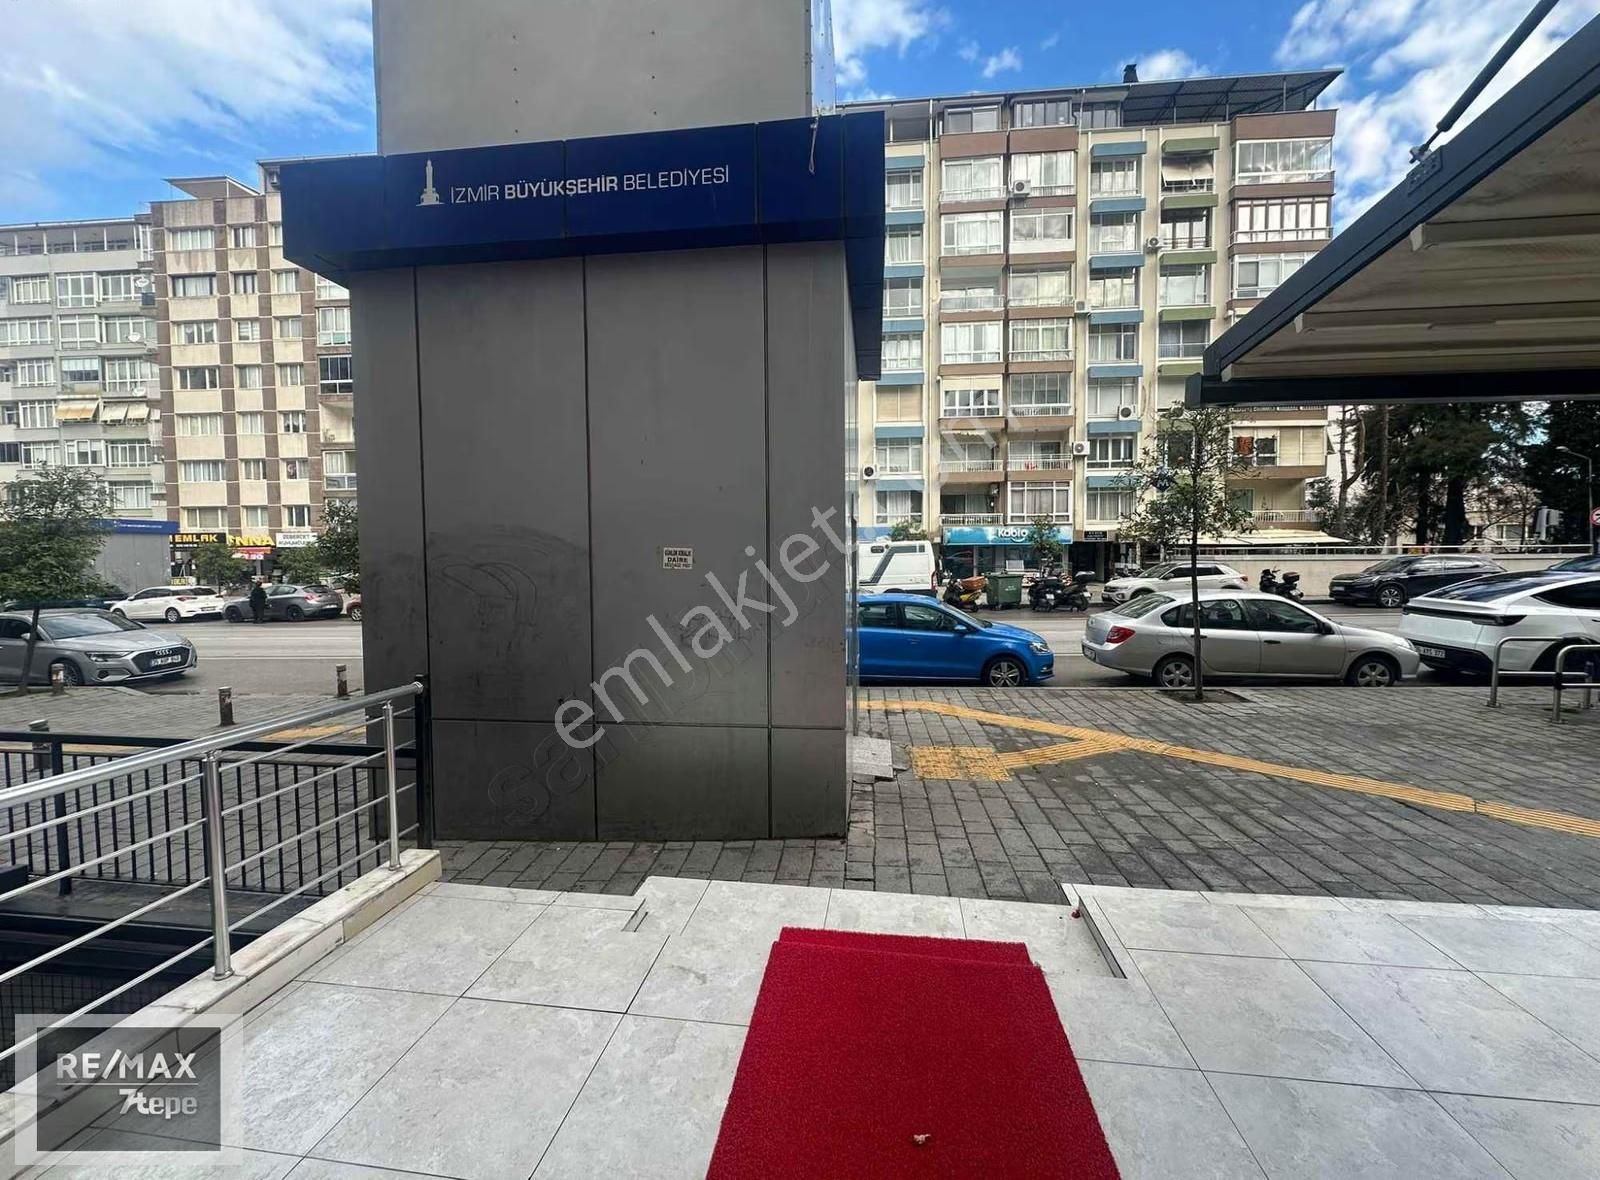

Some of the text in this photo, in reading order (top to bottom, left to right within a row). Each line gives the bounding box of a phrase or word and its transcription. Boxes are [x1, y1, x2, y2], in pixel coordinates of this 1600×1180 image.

[450, 164, 730, 204] İZMİR BÜYÜKŞEHİR BELEDİYESİ
